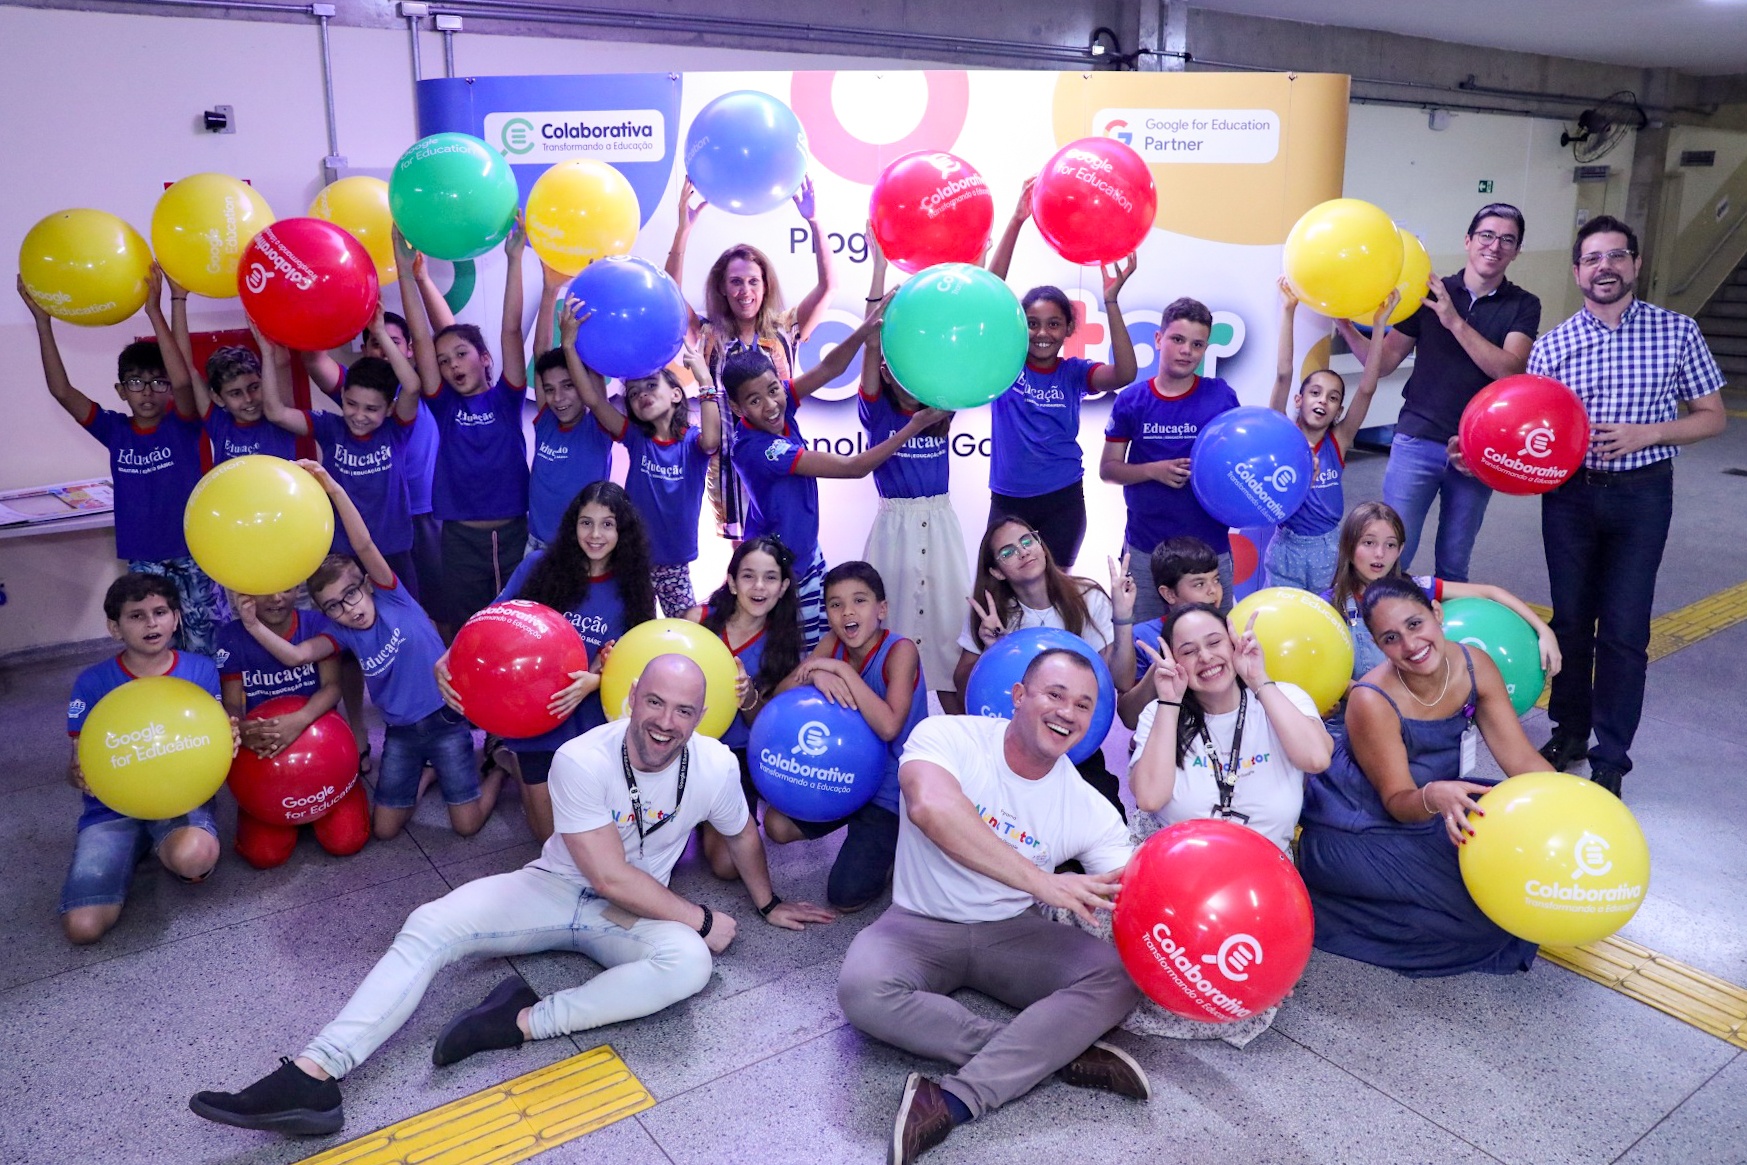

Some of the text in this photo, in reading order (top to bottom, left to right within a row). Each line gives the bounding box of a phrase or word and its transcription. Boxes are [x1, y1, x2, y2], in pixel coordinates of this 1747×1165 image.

[541, 121, 653, 139] Colaborativa
[1145, 118, 1270, 133] Google for Education
[542, 142, 604, 152] Transformando
[613, 141, 653, 152] Educação
[1144, 136, 1204, 151] Partner
[400, 157, 414, 172] for
[1064, 150, 1113, 174] oogle
[1075, 166, 1133, 213] Education
[253, 232, 313, 291] Colaborativ
[1143, 422, 1198, 436] Educação
[117, 446, 172, 466] Eduação
[1483, 446, 1569, 478] Colaborativa
[1480, 457, 1528, 481] Transformando
[1234, 462, 1286, 520] Colaborativa
[512, 619, 542, 640] Educação
[105, 722, 166, 749] Google
[110, 734, 211, 770] for Education
[759, 762, 808, 787] Transformando
[816, 782, 852, 794] Educação
[760, 748, 855, 785] Colaborativa
[281, 784, 336, 809] Google
[284, 809, 307, 821] for
[1004, 821, 1041, 849] Tutor
[1524, 879, 1642, 902] Colaborativa
[1524, 897, 1596, 914] Transformando
[1141, 931, 1197, 999] Transformando
[1152, 922, 1252, 1018] Colaborativa
